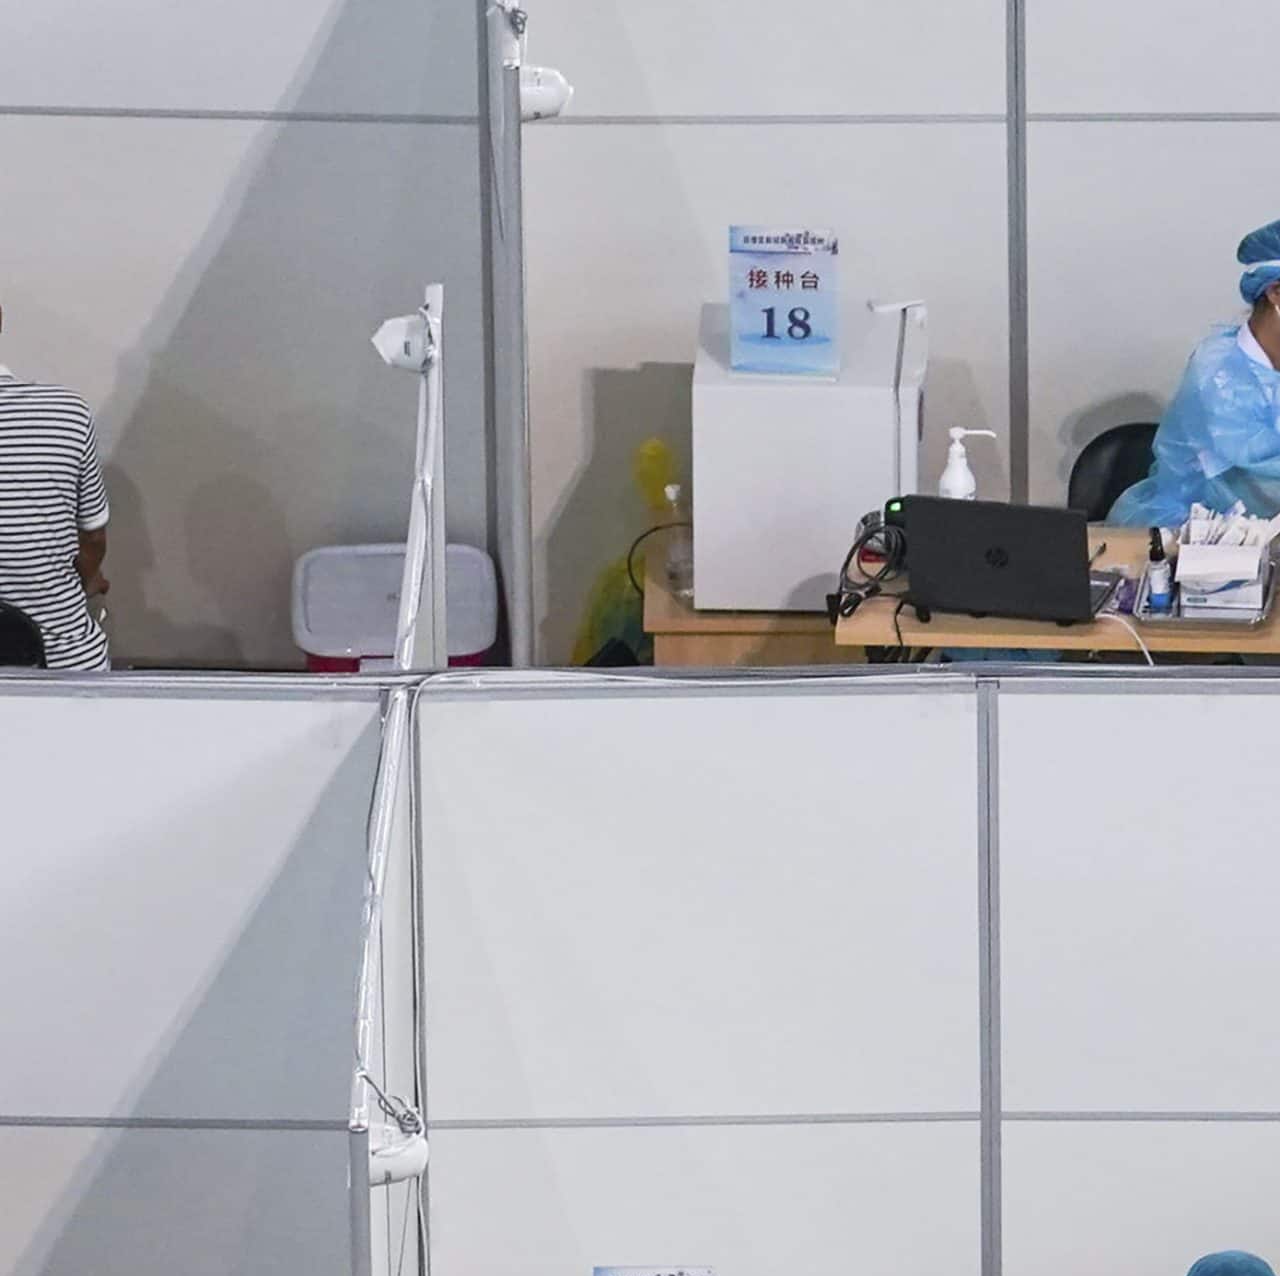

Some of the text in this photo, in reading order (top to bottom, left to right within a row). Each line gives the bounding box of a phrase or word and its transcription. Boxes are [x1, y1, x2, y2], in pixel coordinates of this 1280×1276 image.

[749, 269, 820, 290] 接种台
[761, 306, 812, 341] 18
